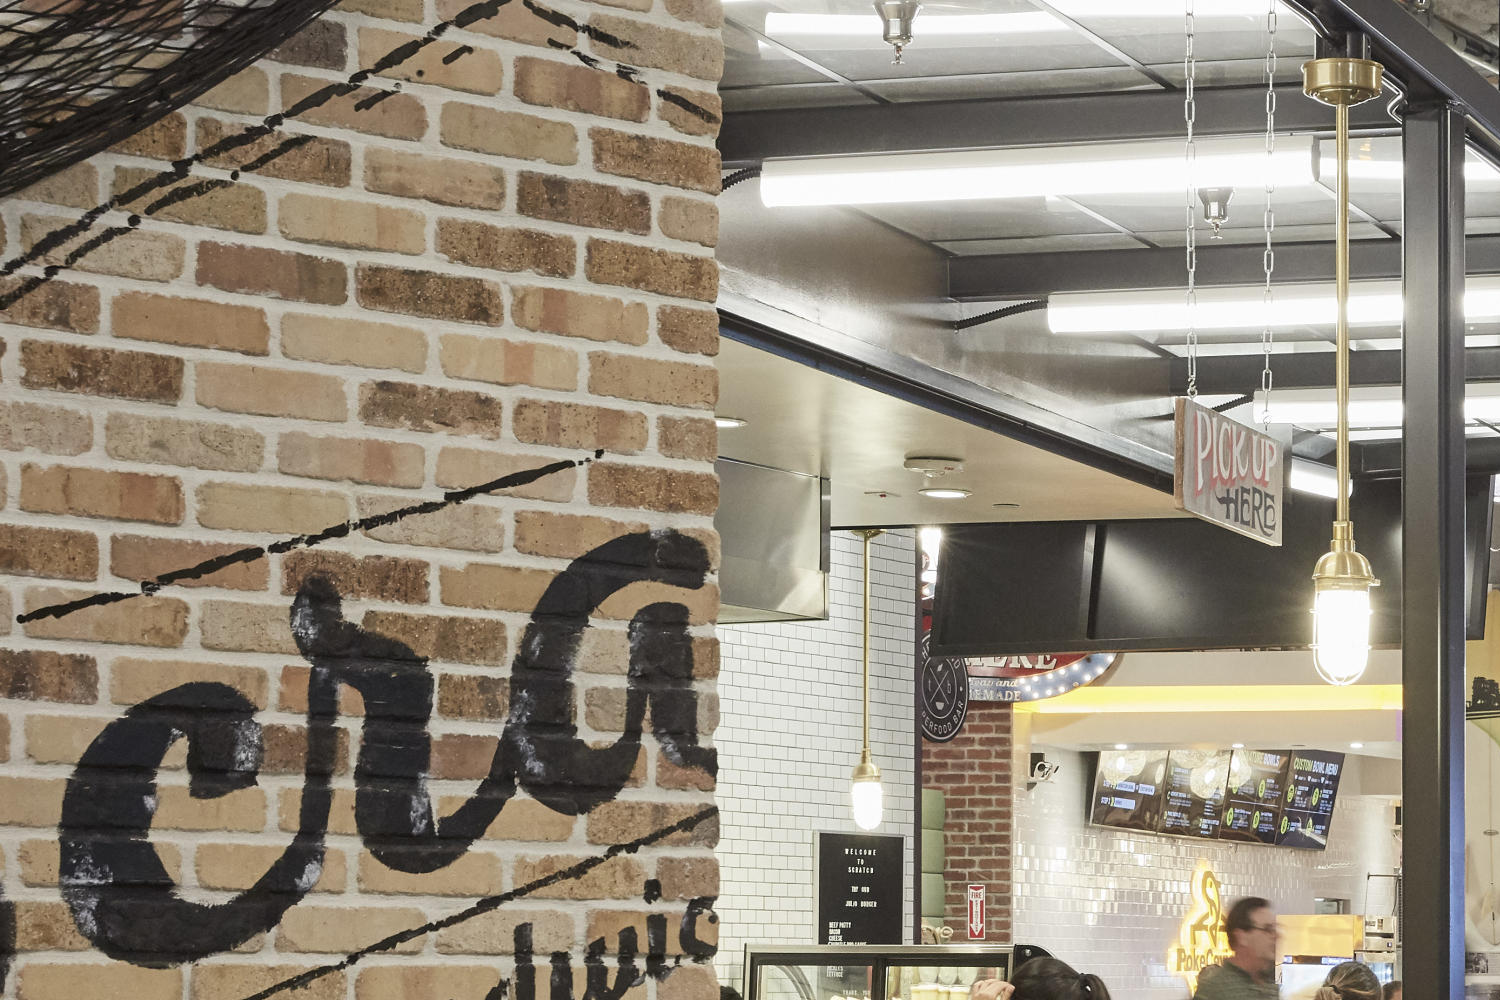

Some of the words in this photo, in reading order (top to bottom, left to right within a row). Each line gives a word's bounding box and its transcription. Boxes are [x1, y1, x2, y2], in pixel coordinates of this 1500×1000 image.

[1195, 409, 1249, 494] PICK
[1251, 435, 1277, 484] UP
[1216, 485, 1277, 538] HERE
[952, 700, 965, 724] BAR
[1294, 757, 1313, 772] CUSTOM
[1312, 760, 1325, 774] BOWL
[845, 848, 876, 856] WELCOME
[847, 866, 874, 874] SCRATCH
[1176, 947, 1233, 971] PokeCev
